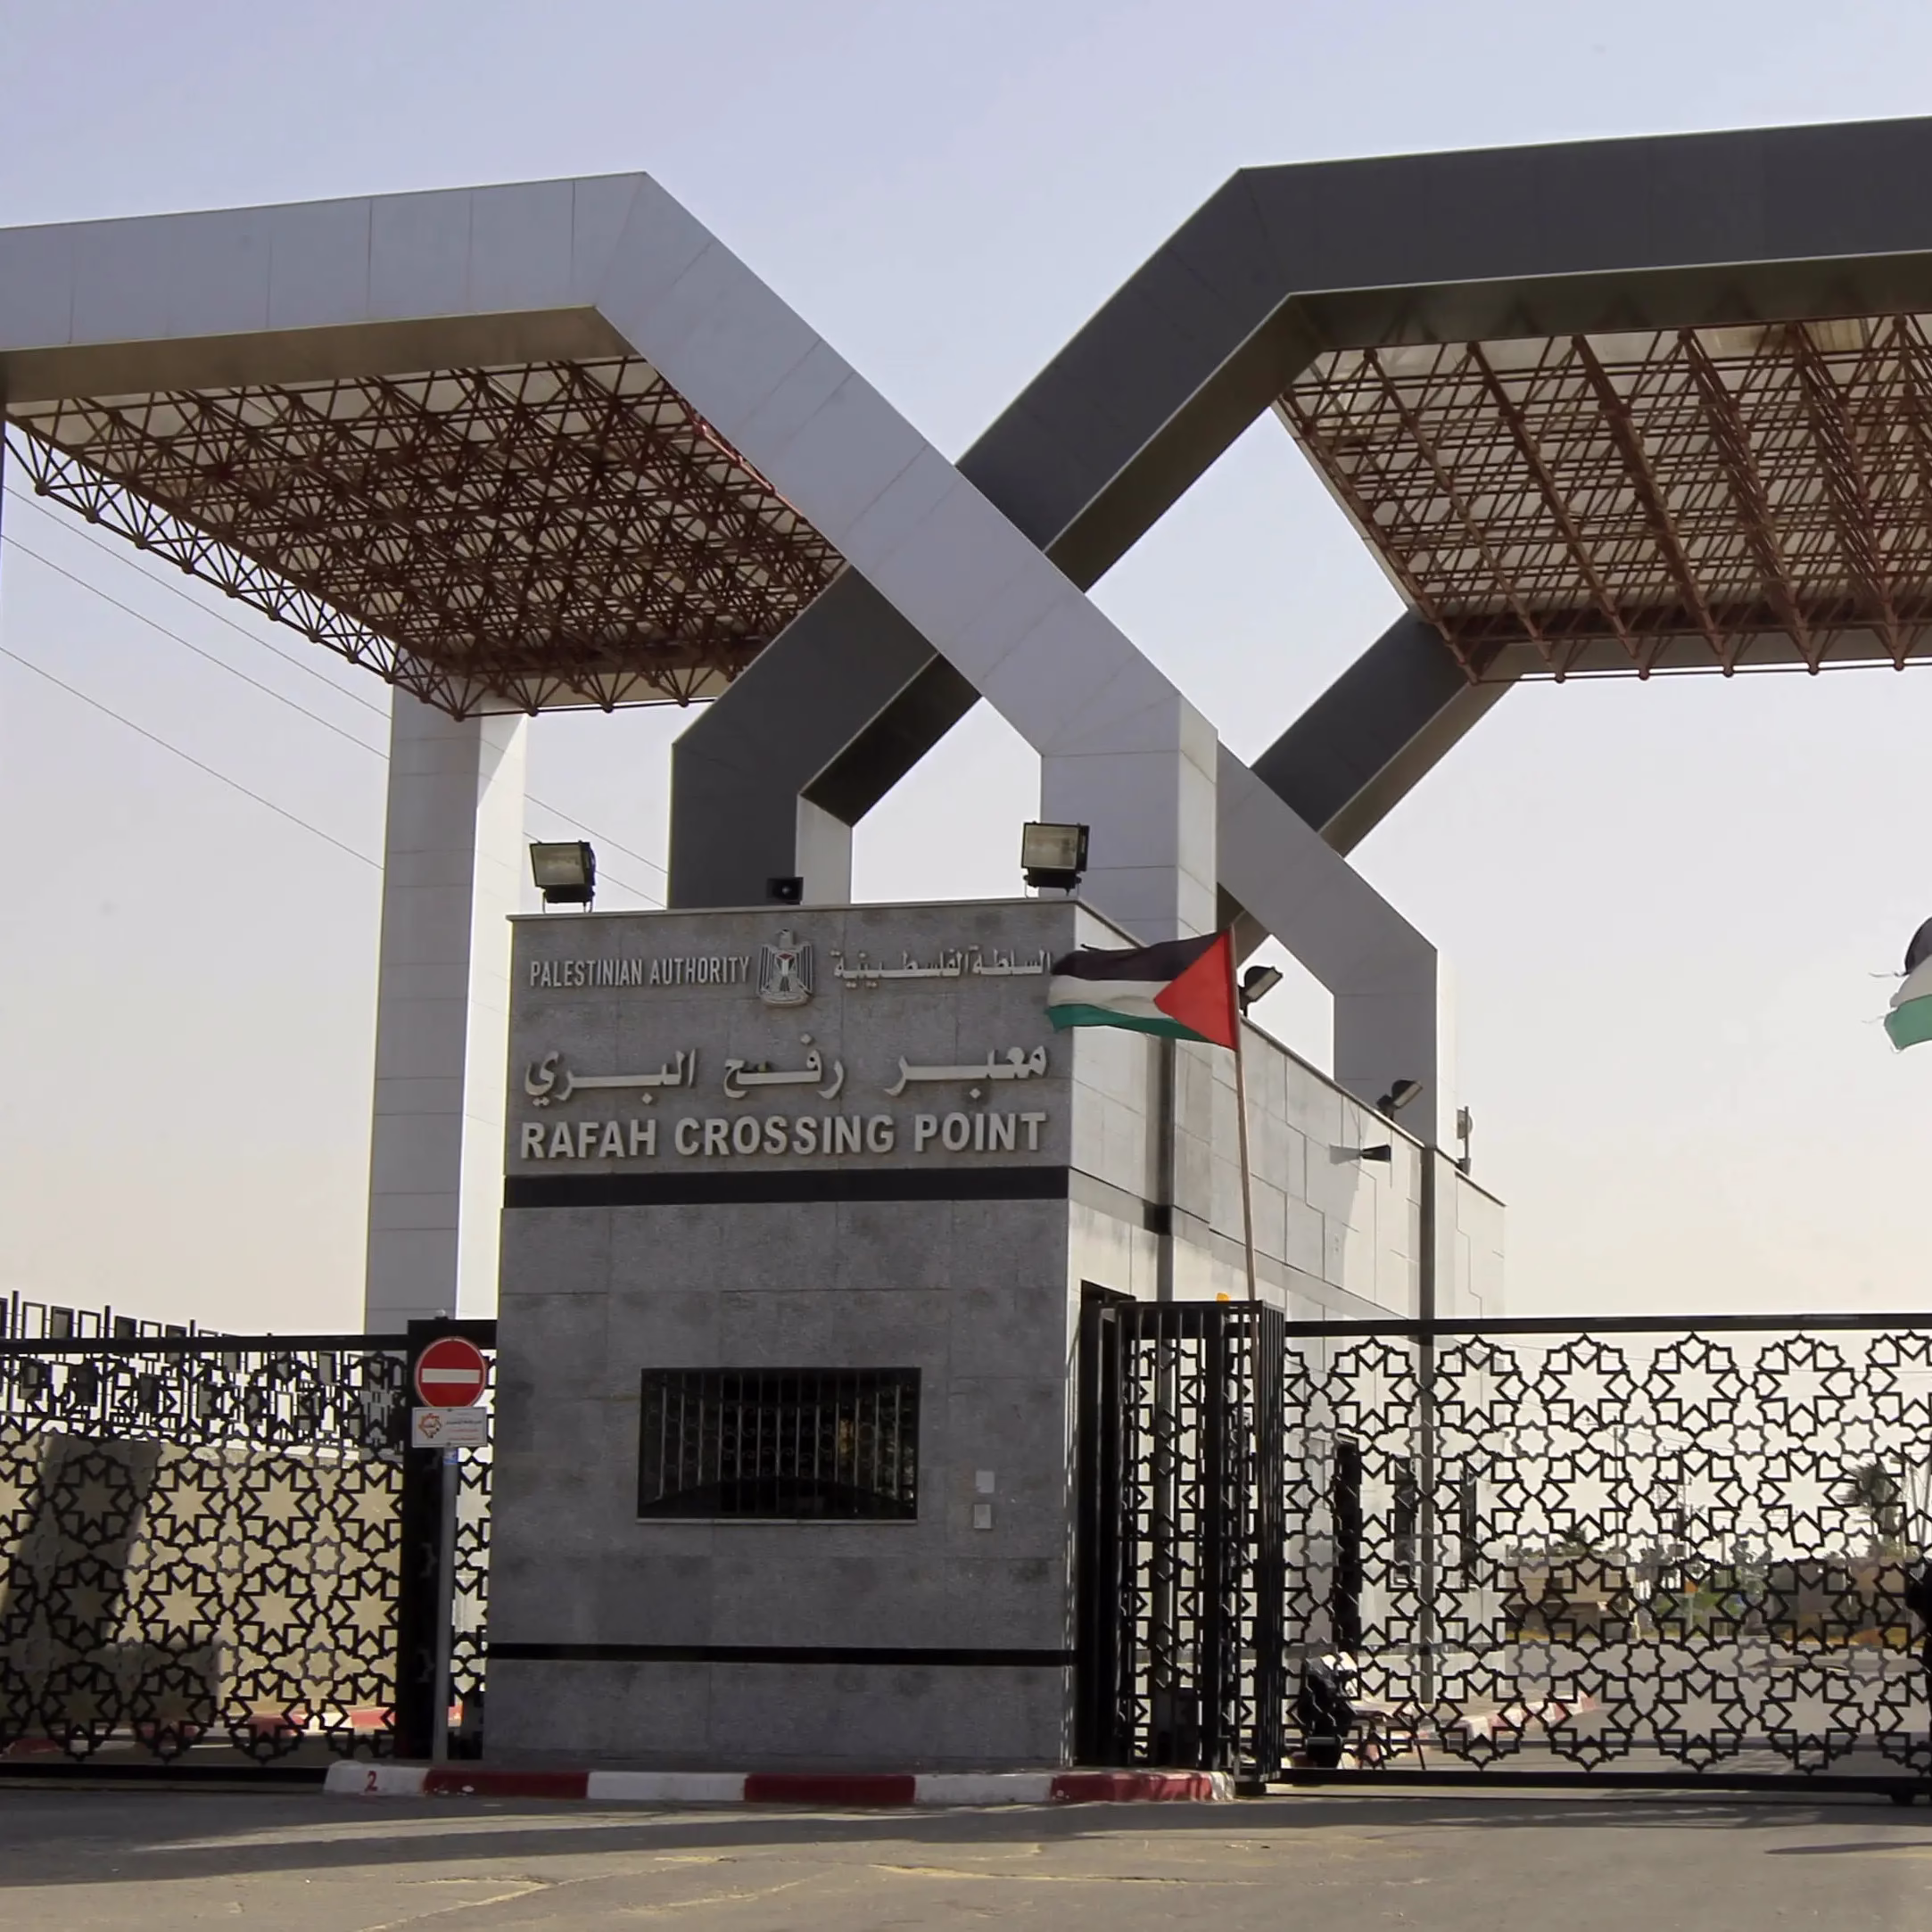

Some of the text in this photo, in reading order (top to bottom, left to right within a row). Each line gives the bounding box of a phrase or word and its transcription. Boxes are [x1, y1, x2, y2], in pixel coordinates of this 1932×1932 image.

[530, 956, 749, 987] PALESTINIAN AUTHORITY
[830, 945, 1051, 987] السلطة الفلسطينية
[524, 1034, 1047, 1106] معبر رفح البري
[521, 1112, 1047, 1158] RAFAH CROSSING POINT
[365, 1771, 378, 1792] 2
